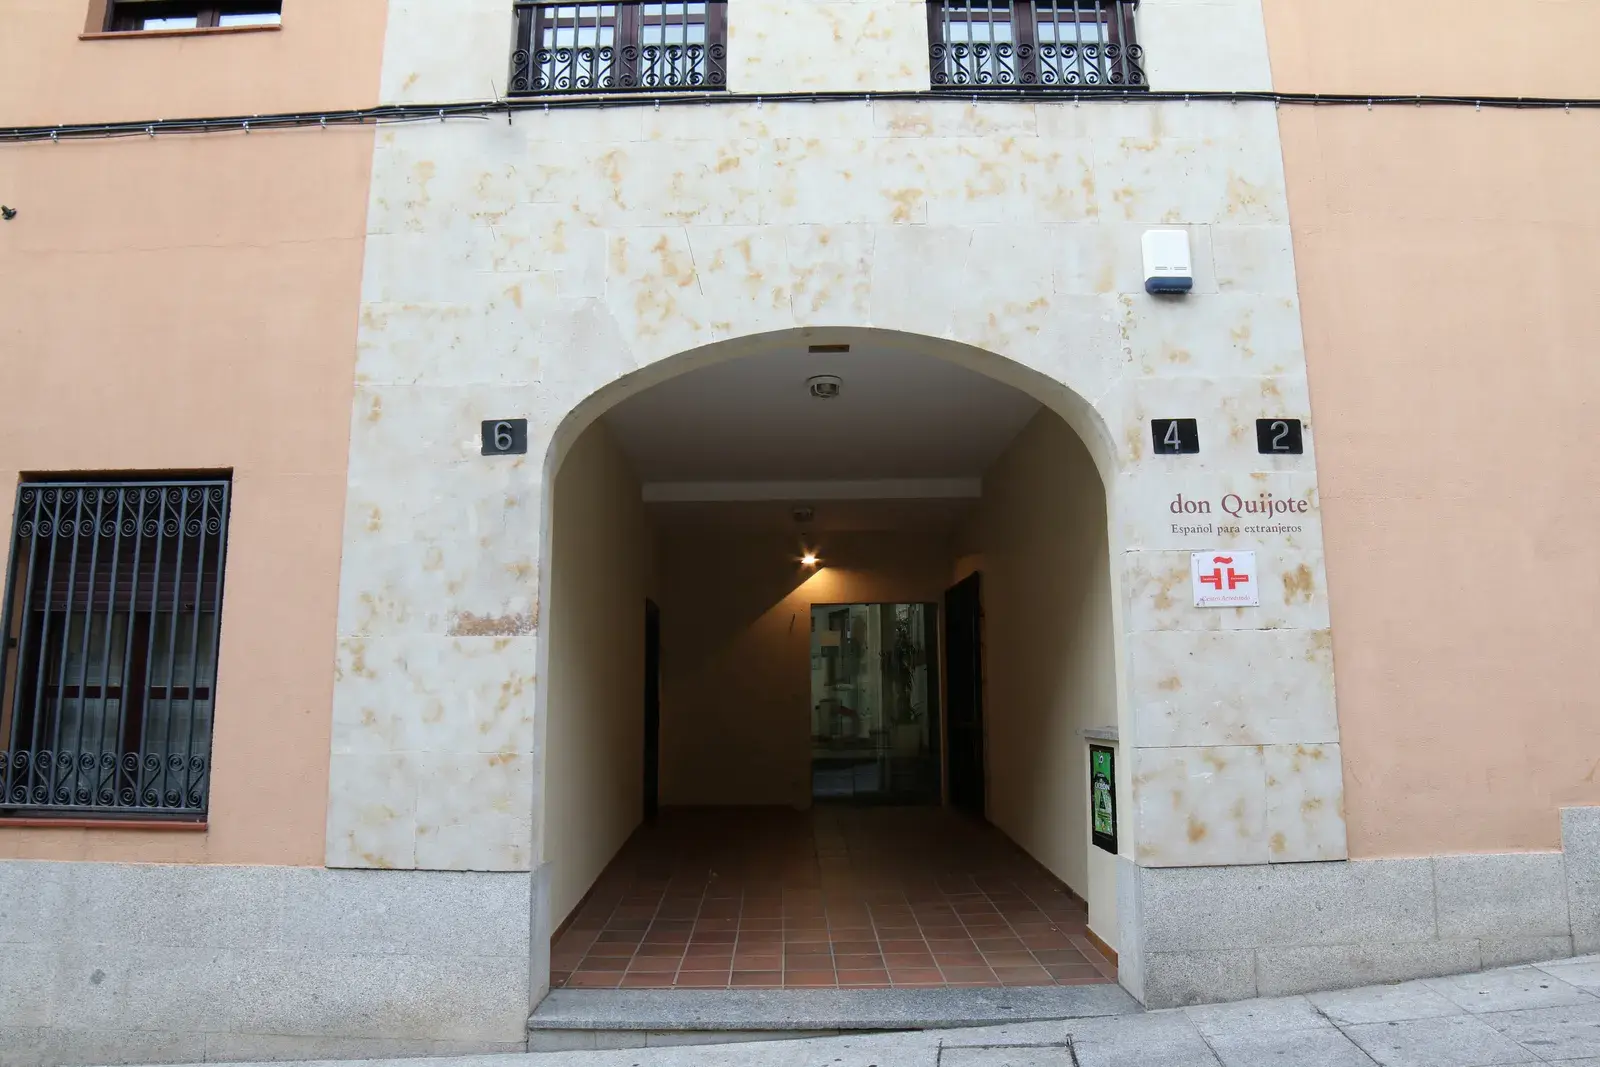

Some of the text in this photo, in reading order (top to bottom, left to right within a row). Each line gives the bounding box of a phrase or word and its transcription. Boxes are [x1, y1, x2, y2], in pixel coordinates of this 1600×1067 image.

[494, 421, 513, 450] 6
[1163, 420, 1181, 450] 4
[1270, 420, 1290, 450] 2
[1169, 493, 1308, 519] don Quijote
[1171, 522, 1302, 536] Español para extranjeros
